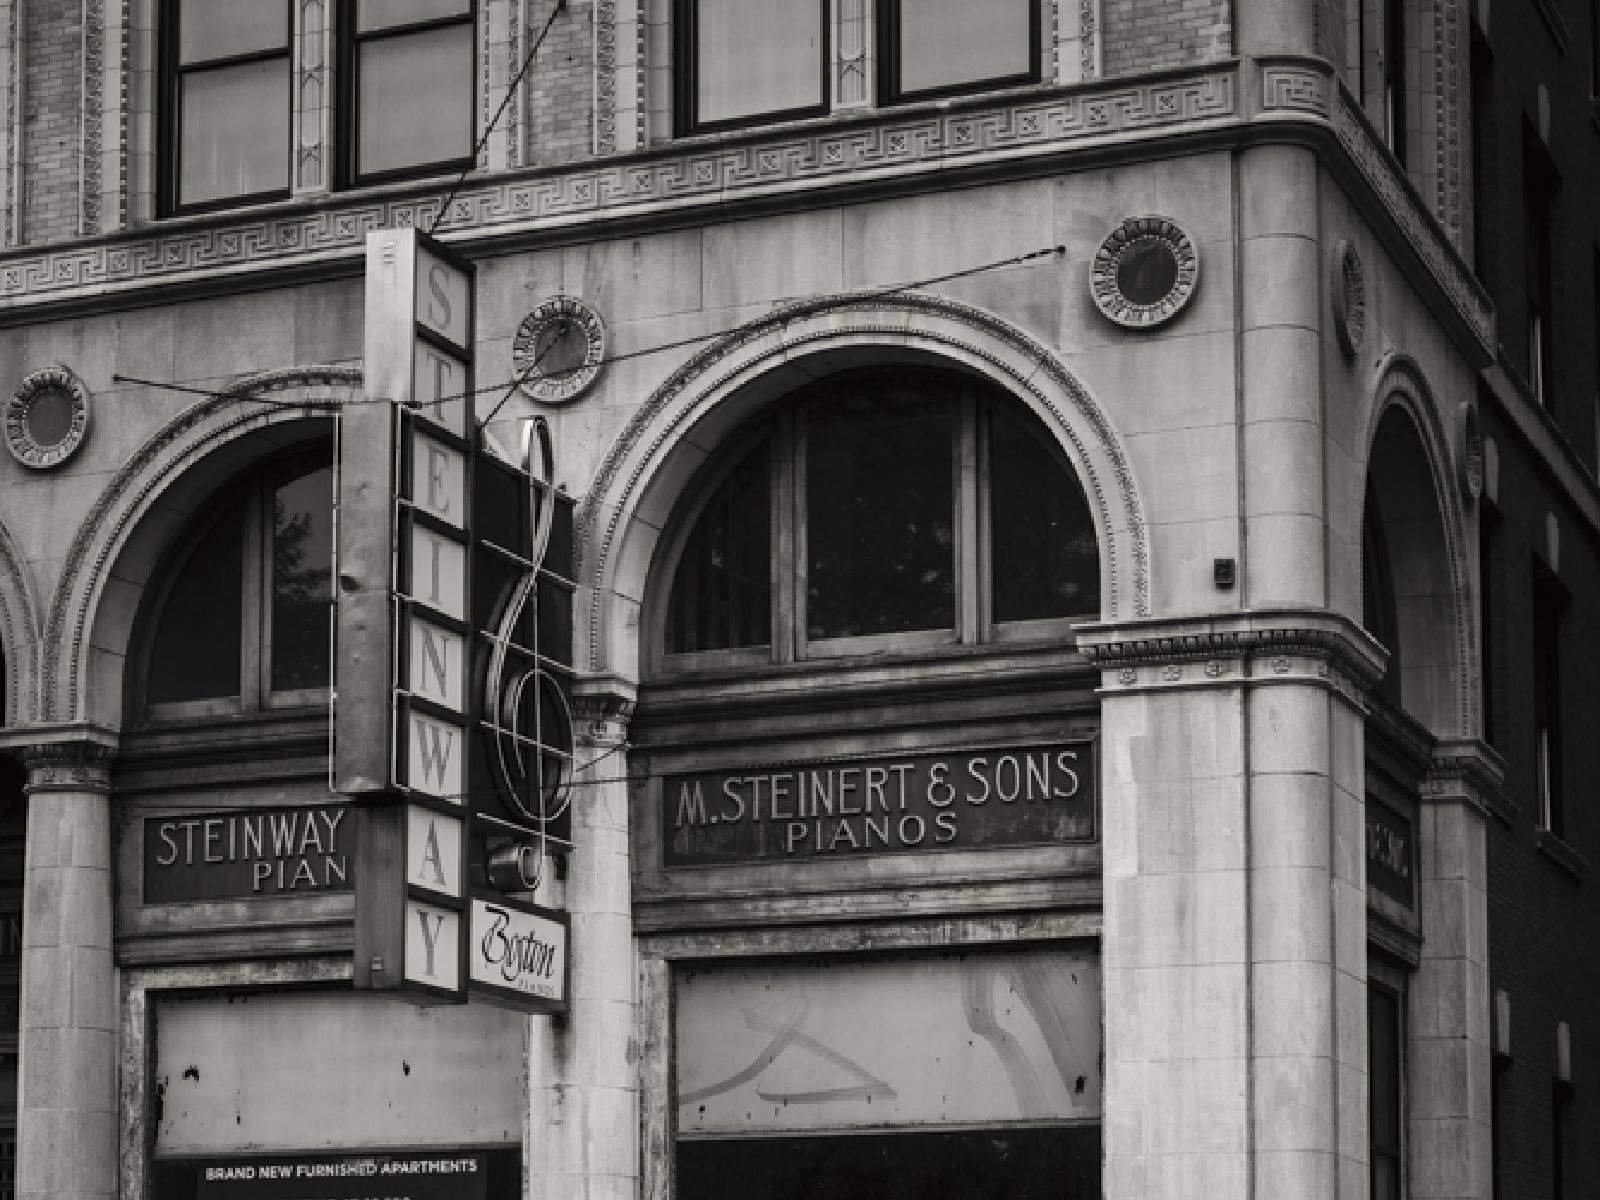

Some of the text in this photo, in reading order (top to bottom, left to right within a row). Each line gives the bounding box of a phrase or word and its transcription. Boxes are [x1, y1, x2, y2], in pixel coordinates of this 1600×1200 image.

[415, 263, 453, 978] STEINWAY
[927, 762, 957, 808] &
[966, 751, 1079, 805] SONS
[156, 808, 346, 866] STEINWAY
[786, 811, 958, 854] PIANOS
[205, 1158, 478, 1181] BRAND NEW FURNISHED APARTMENTS
